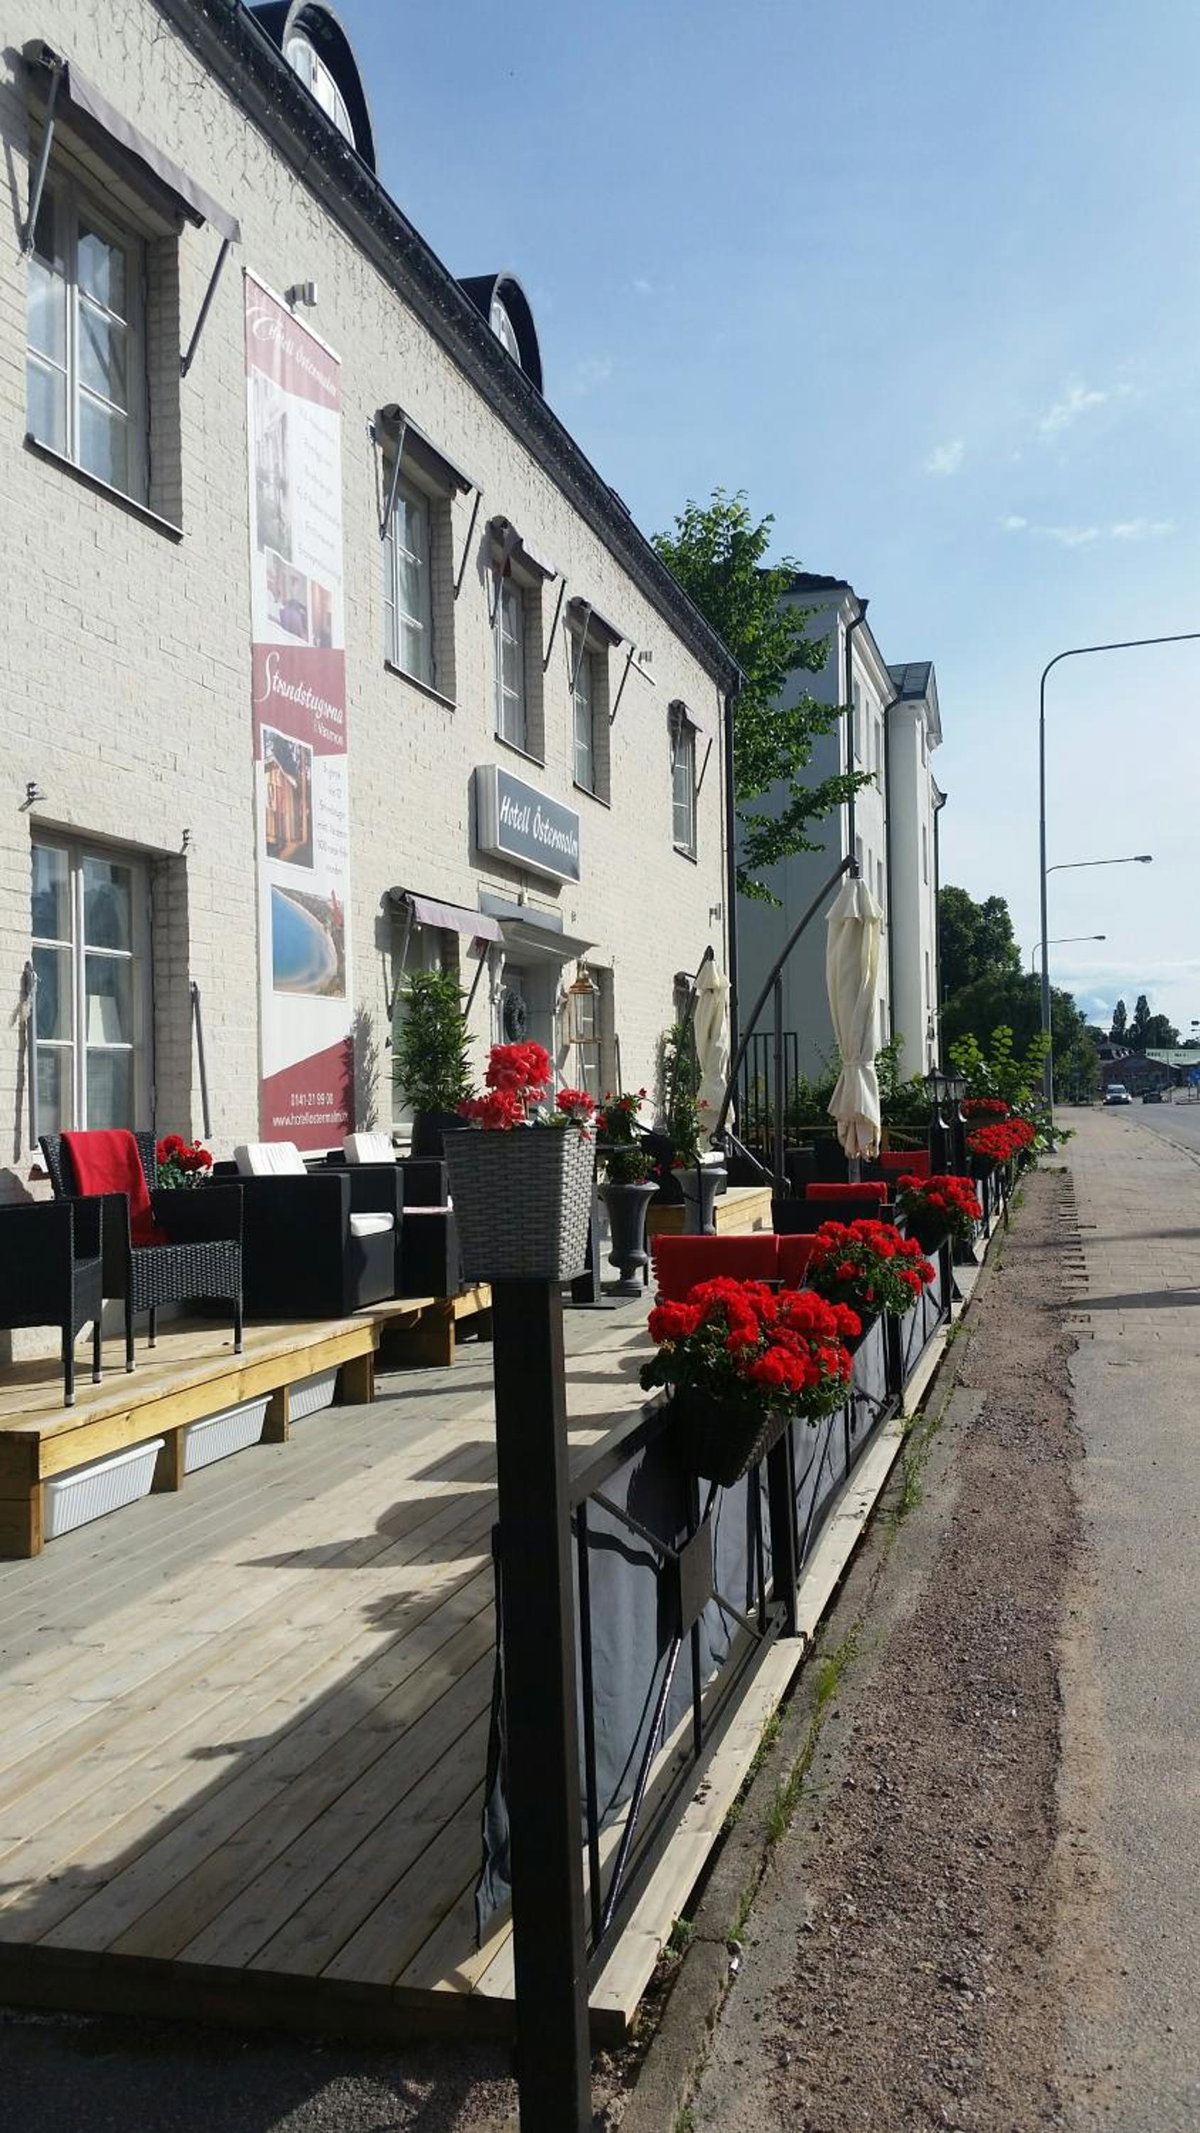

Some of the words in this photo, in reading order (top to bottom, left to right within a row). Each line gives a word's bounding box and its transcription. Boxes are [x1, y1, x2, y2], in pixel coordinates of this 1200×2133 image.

[253, 651, 343, 724] Strandstugorna
[500, 796, 530, 834] Hotell
[533, 805, 578, 858] Östermalm
